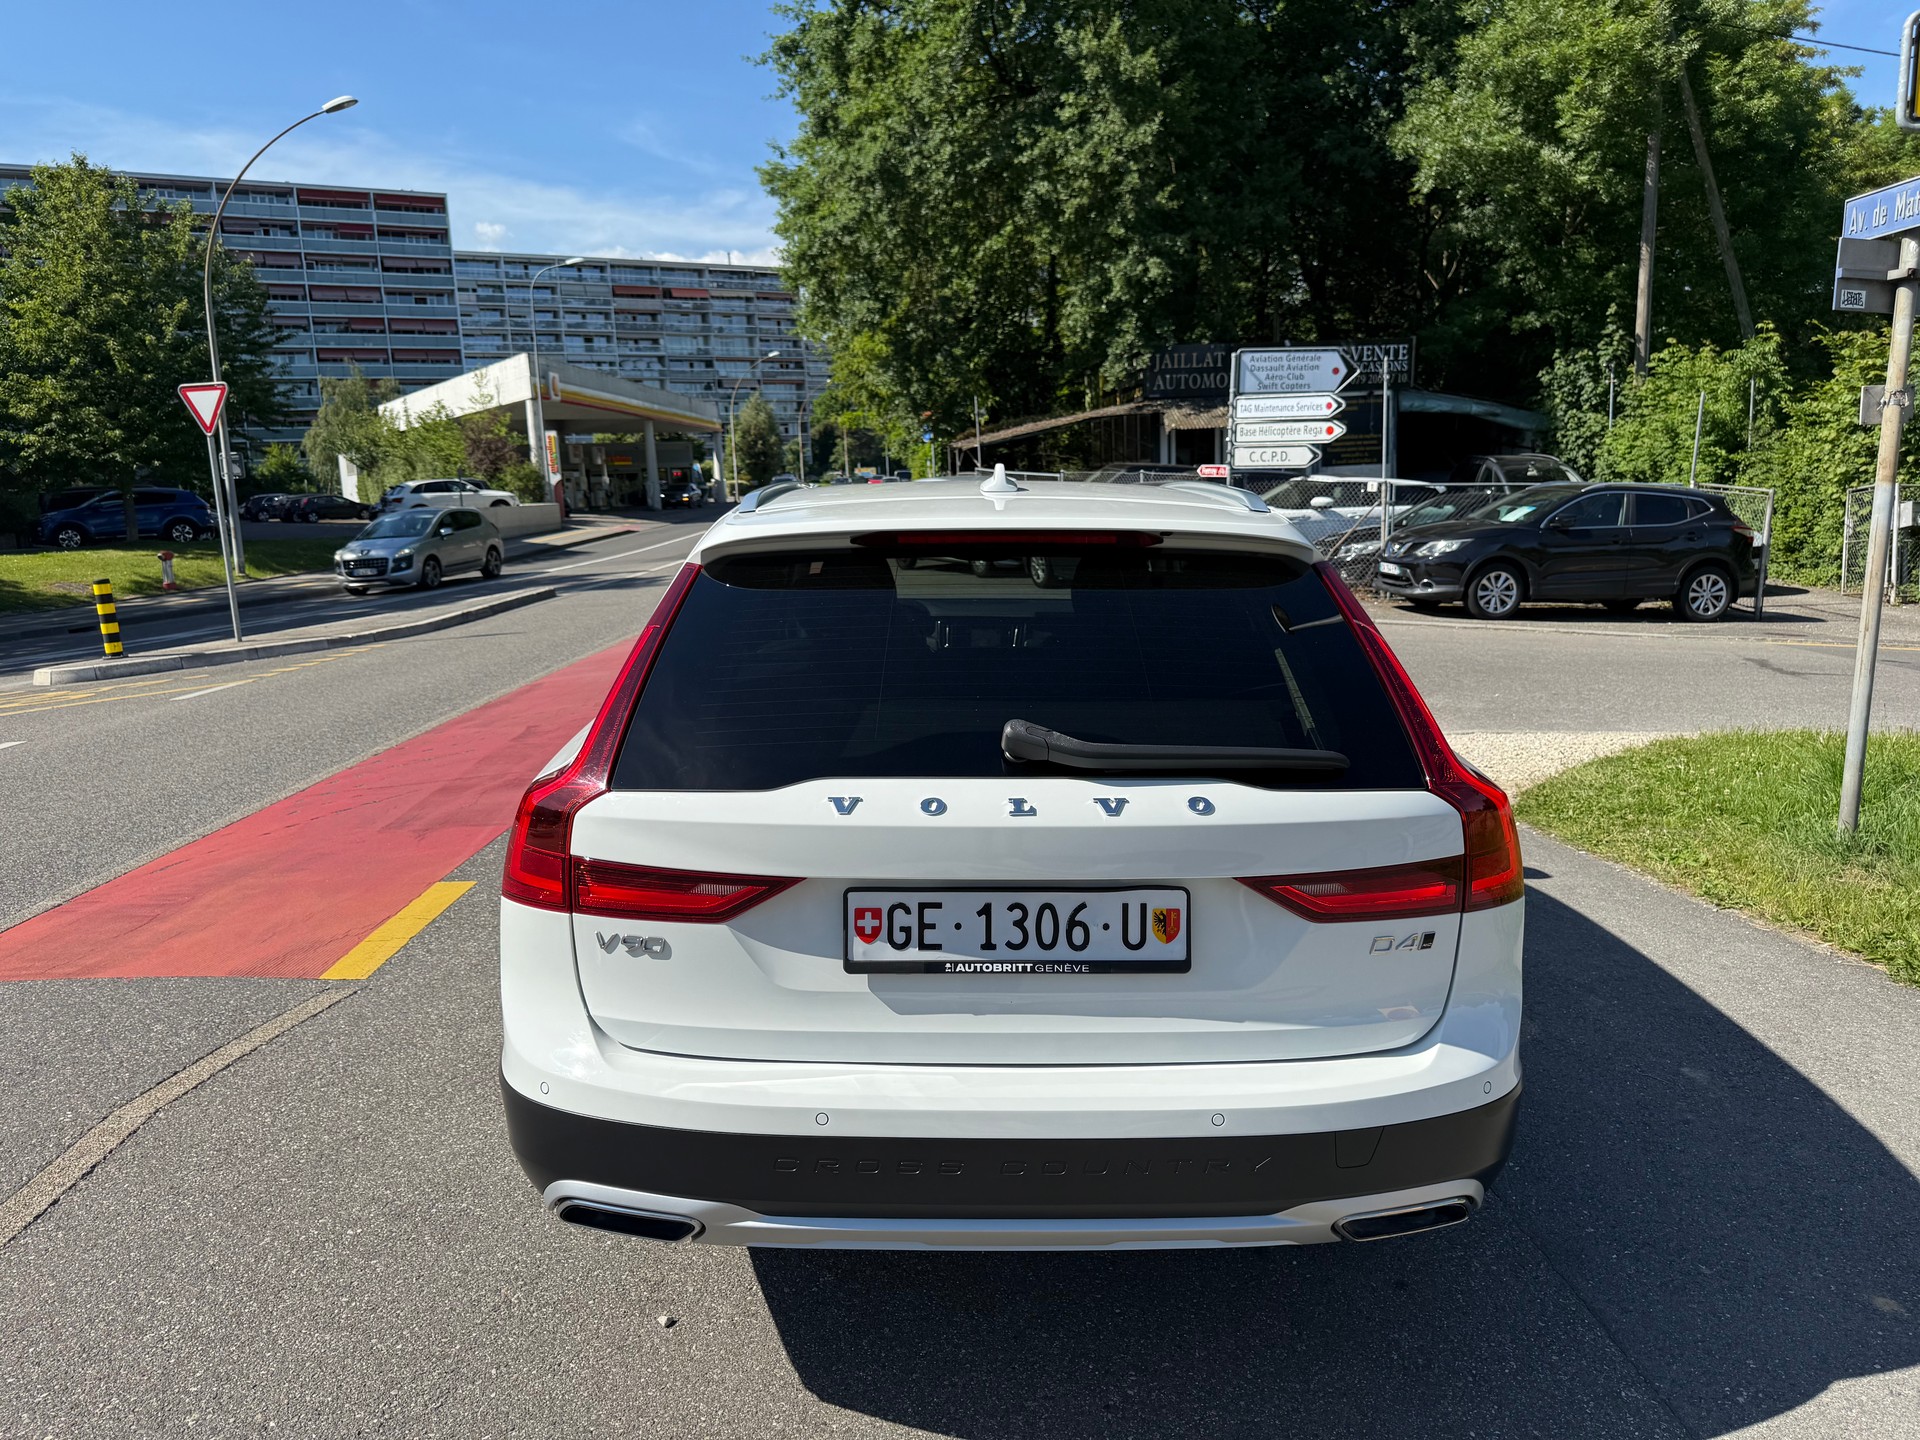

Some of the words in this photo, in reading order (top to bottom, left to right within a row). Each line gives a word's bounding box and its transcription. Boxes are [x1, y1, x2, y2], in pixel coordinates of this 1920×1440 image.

[1848, 206, 1868, 235] Av.
[1873, 199, 1888, 228] de
[1249, 355, 1283, 363] Aviation
[1285, 354, 1321, 363] Générale
[1351, 344, 1409, 361] VENTE
[1153, 352, 1226, 372] JAILLAT
[1250, 364, 1285, 373] Dassault
[1286, 363, 1320, 372] Aviation
[1152, 372, 1229, 391] AUTOMO
[1264, 373, 1305, 381] Aéro-Club
[1257, 382, 1278, 391] Swift
[1280, 382, 1311, 391] Copters
[1254, 402, 1296, 412] Maintenance
[1296, 402, 1323, 411] Services
[1240, 427, 1257, 437] Base
[1258, 425, 1301, 438] Hélicoptère
[1303, 426, 1323, 437] Rega
[1249, 451, 1291, 463] C.C.P.D.
[828, 795, 1216, 817] VOLVO
[595, 930, 668, 956] V90
[1369, 932, 1419, 955] D4
[955, 963, 1035, 973] AUTOBRITT
[1035, 962, 1090, 973] GENÈVE
[772, 1157, 967, 1176] CROSS
[998, 1156, 1272, 1176] COUNTRY
